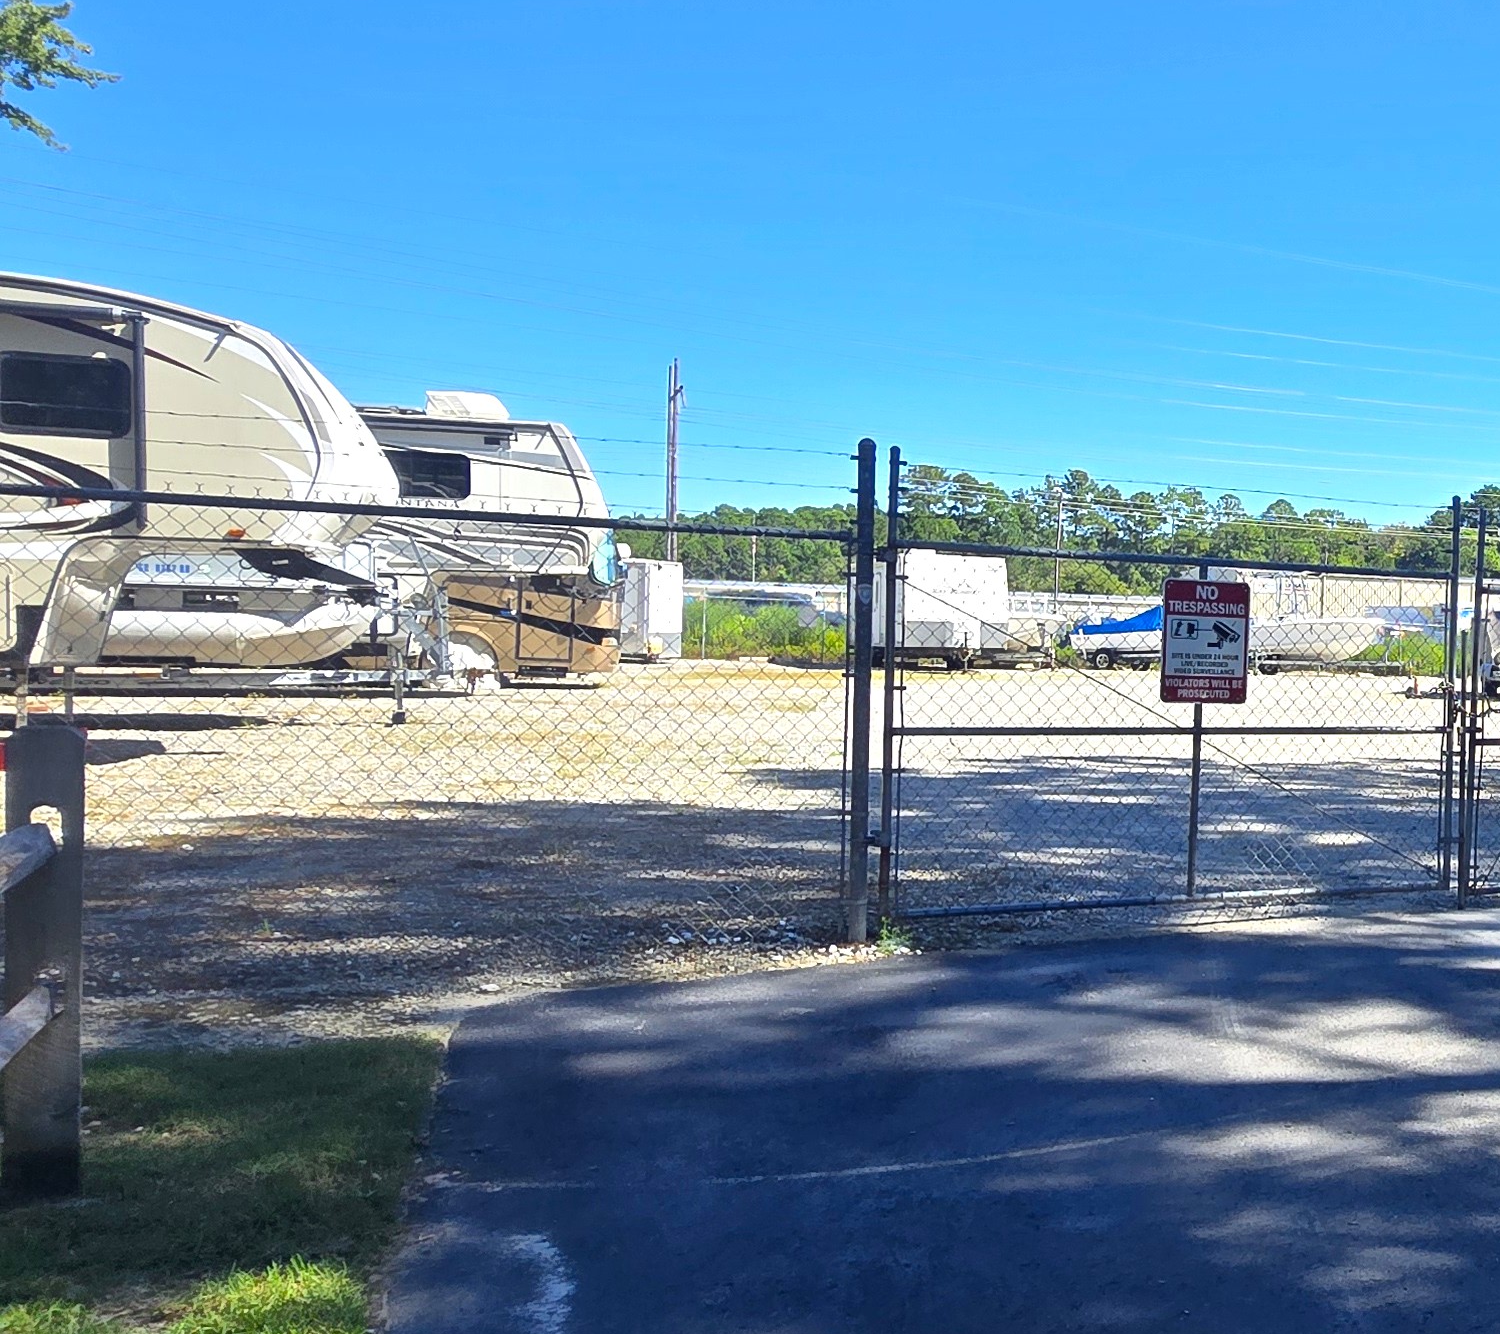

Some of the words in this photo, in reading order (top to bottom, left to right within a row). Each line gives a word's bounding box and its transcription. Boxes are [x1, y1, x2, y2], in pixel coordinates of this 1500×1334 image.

[1196, 585, 1219, 600] NO
[1168, 600, 1245, 615] TRESPASSING
[1165, 678, 1209, 688] VIOLATORS
[1211, 679, 1230, 688] WILL
[1232, 680, 1243, 689] BE
[1177, 688, 1230, 699] PROSECUTED
